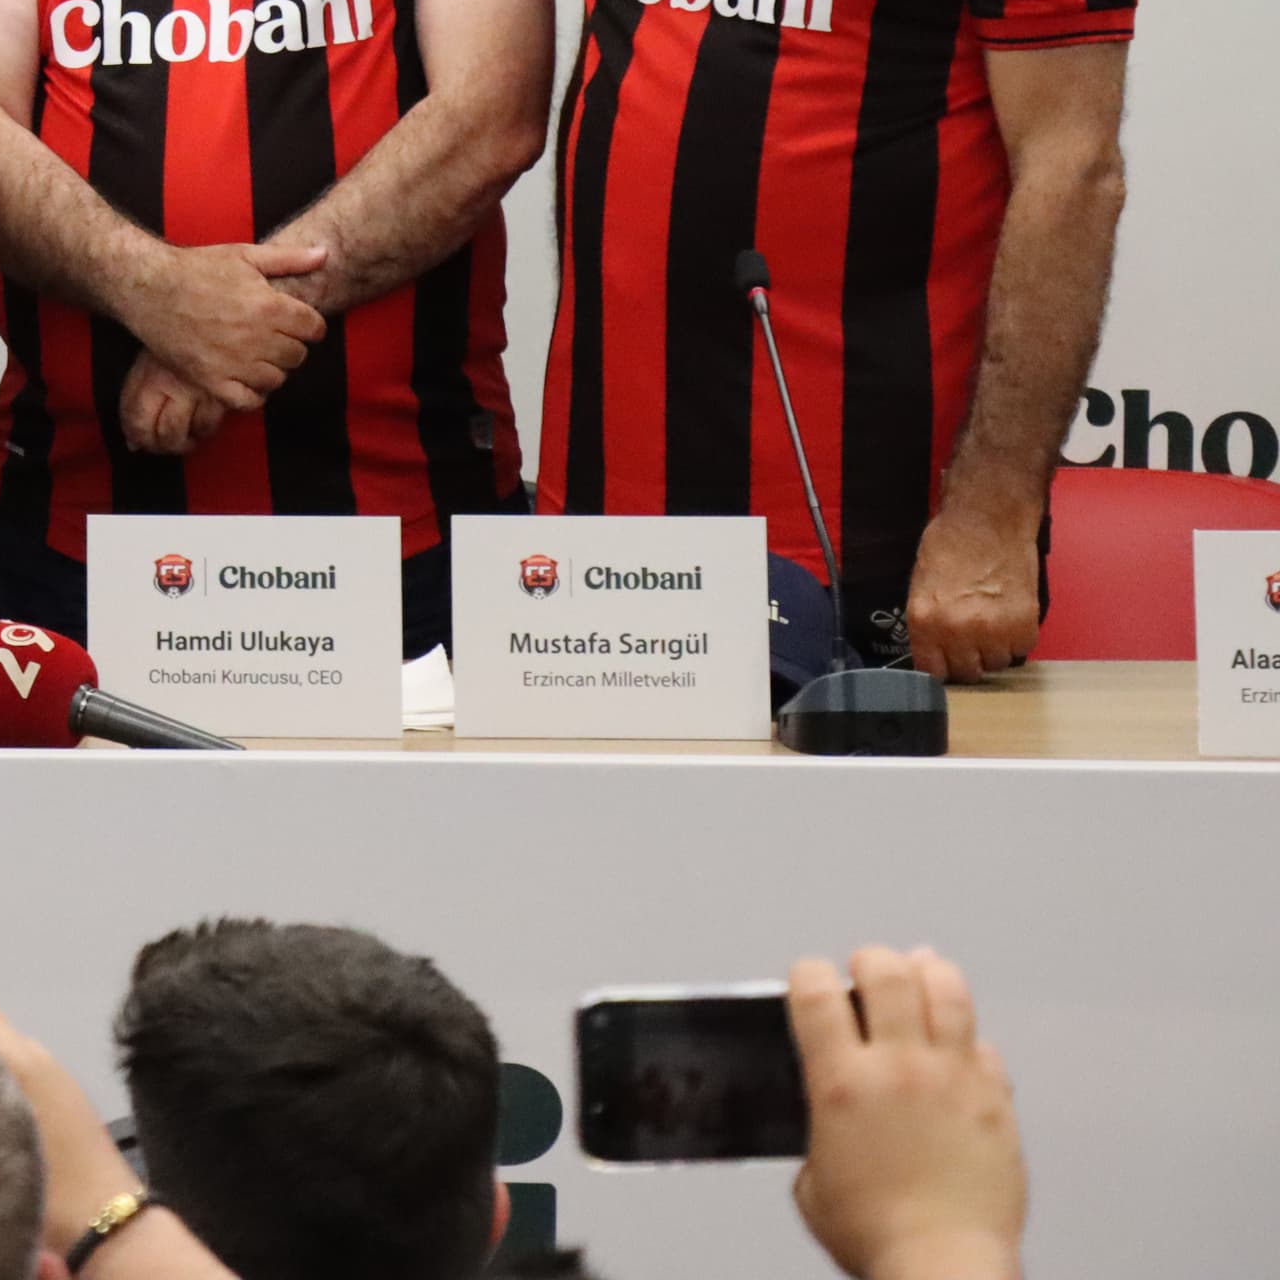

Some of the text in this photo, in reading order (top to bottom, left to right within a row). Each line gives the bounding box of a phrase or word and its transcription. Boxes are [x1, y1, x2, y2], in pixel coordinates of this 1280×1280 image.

[218, 564, 337, 590] Chobani
[584, 565, 703, 591] Chobani
[156, 630, 335, 657] Hamdi Ulukaya
[509, 631, 708, 661] Mustafa Sarıgül
[148, 668, 343, 687] Chobani Kurucusu, CEO
[523, 670, 697, 688] Erzincan Milletvekili
